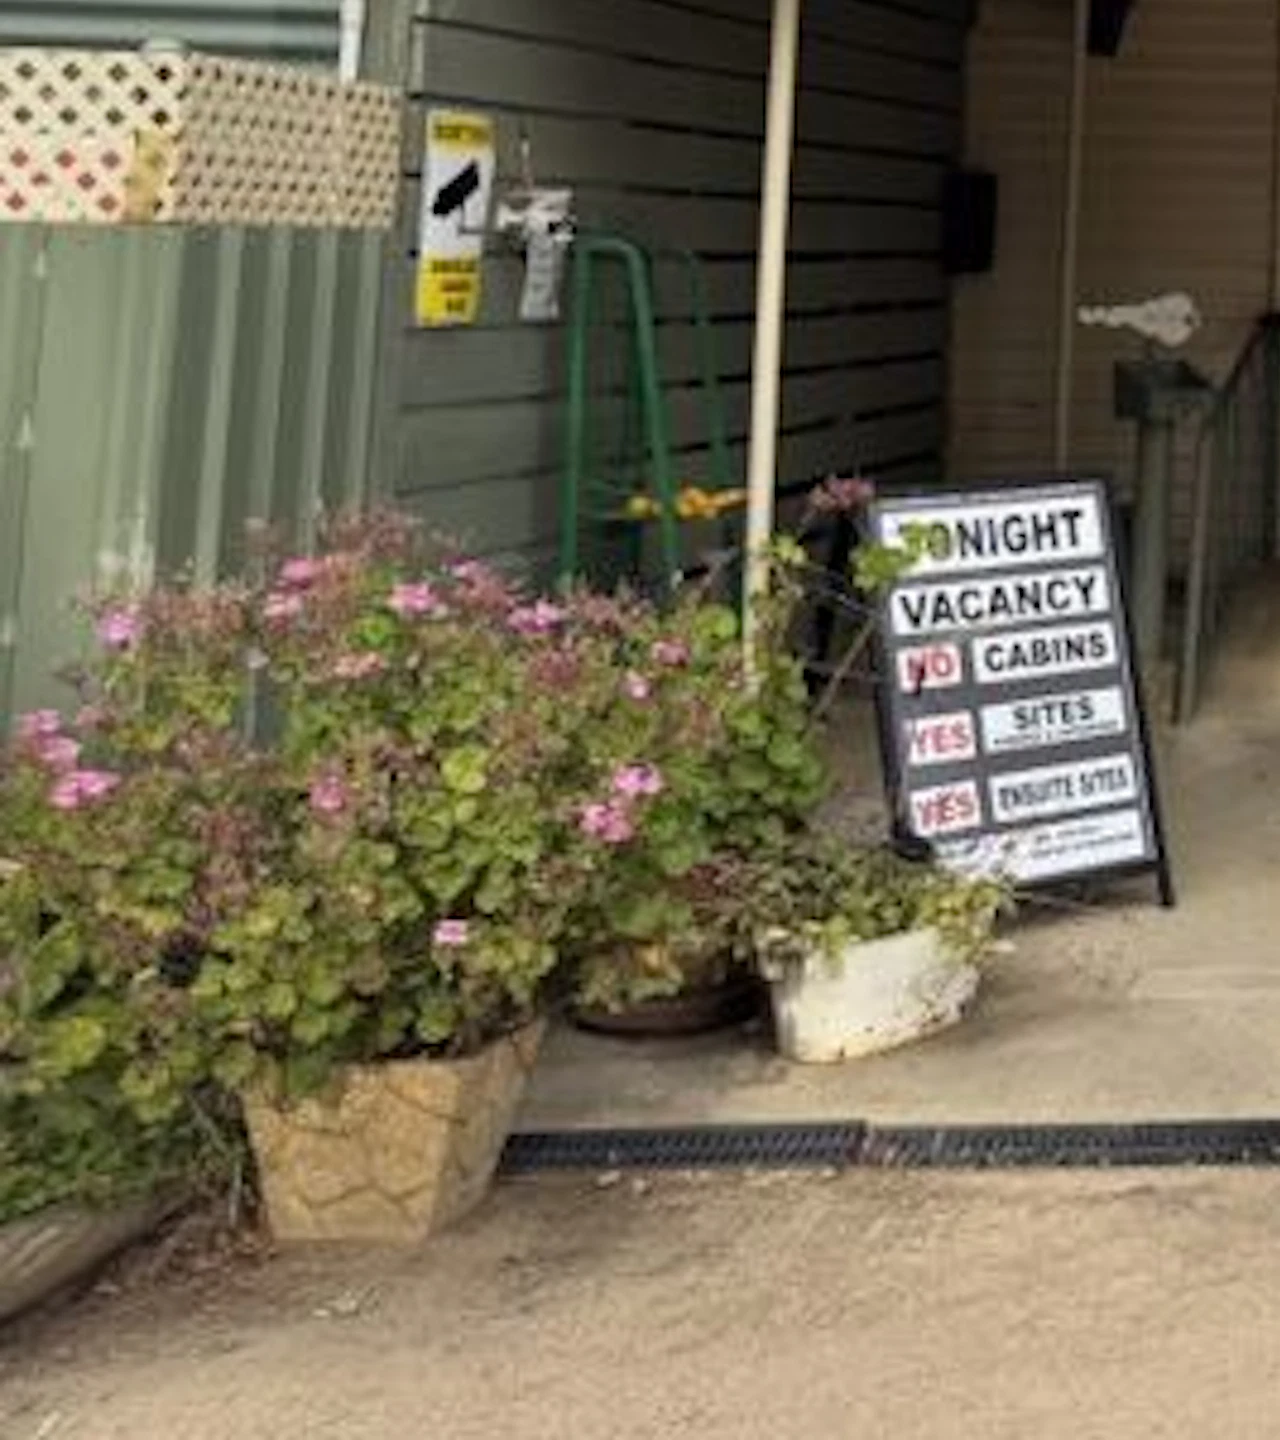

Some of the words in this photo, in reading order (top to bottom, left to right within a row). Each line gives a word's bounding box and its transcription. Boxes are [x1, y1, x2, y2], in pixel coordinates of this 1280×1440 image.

[899, 575, 1095, 628] VACANCY
[984, 630, 1109, 672] CABINS
[916, 721, 972, 755] YES
[1012, 694, 1095, 730] SITES
[916, 786, 976, 826] YES
